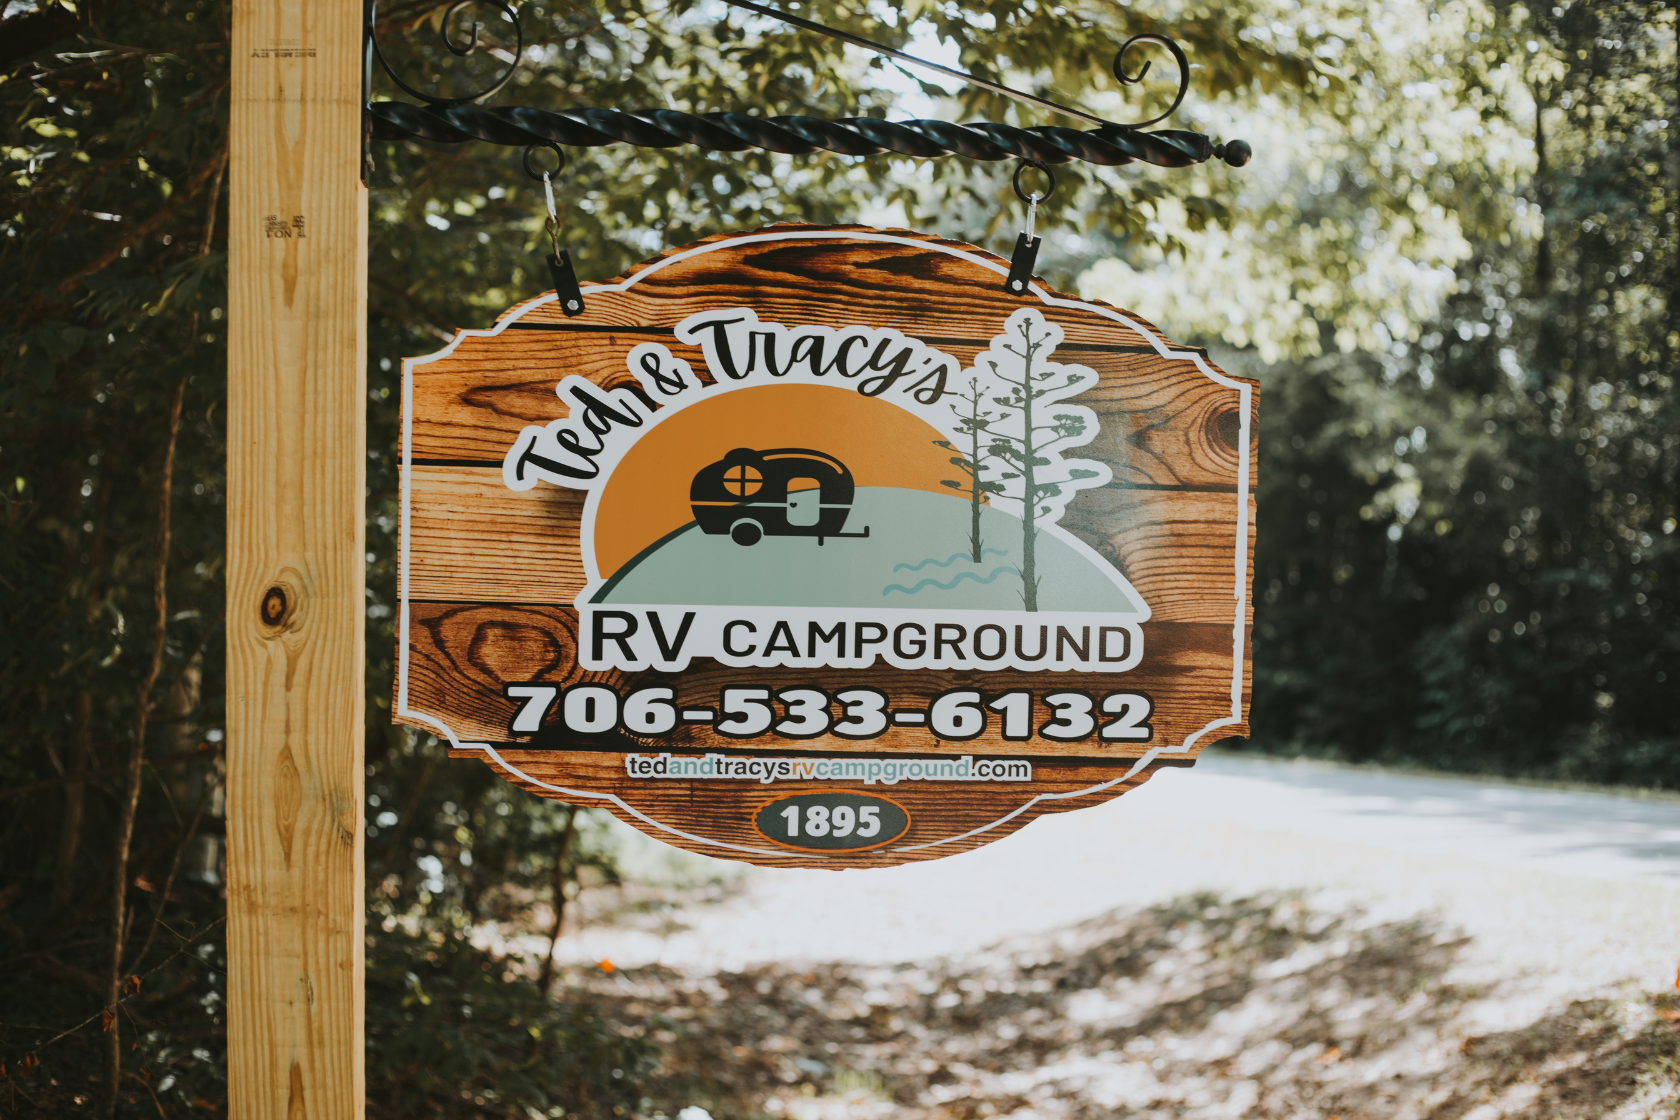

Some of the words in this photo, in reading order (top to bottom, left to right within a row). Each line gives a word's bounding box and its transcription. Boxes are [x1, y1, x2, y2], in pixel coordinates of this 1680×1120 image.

[516, 384, 644, 482] Ted
[640, 352, 689, 395] &
[687, 317, 958, 405] Tracy's
[591, 610, 697, 662] RV
[722, 619, 1132, 663] CAMPGROUND
[505, 684, 1153, 740] 706-533-6132
[628, 755, 1029, 782] tedandtracysrvcampground.com
[779, 805, 882, 838] 1895
